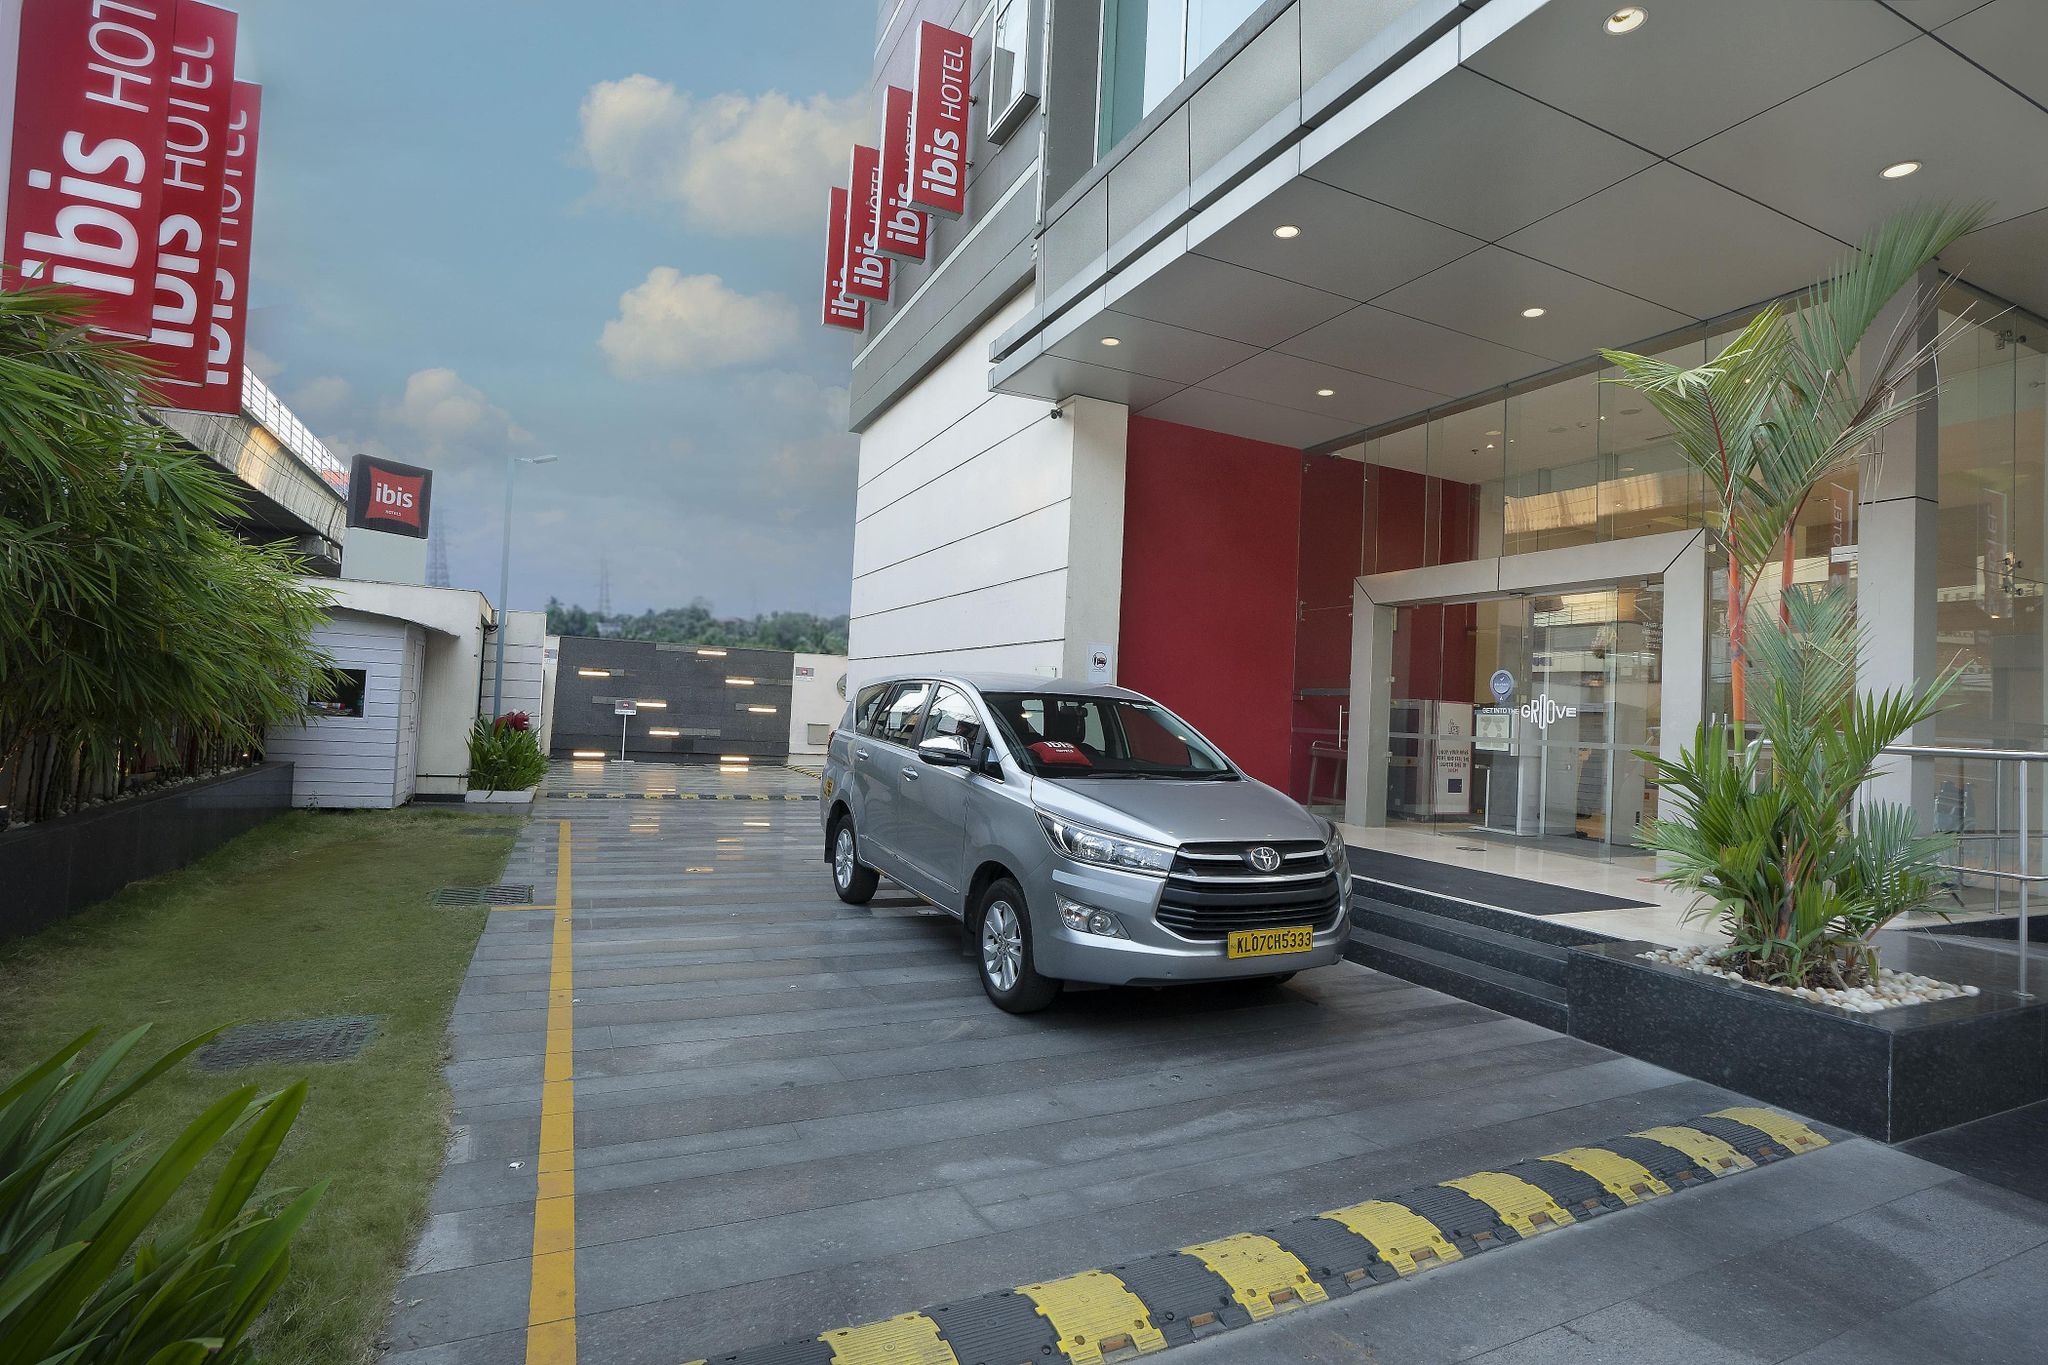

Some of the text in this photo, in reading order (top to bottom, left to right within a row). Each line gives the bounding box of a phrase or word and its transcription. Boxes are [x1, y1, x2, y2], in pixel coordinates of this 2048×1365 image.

[921, 46, 964, 197] ibis HOTEL
[21, 130, 146, 296] ibis
[375, 481, 413, 509] ibis
[1521, 693, 1577, 730] GROOVE
[1237, 931, 1312, 954] KL07CH5333
